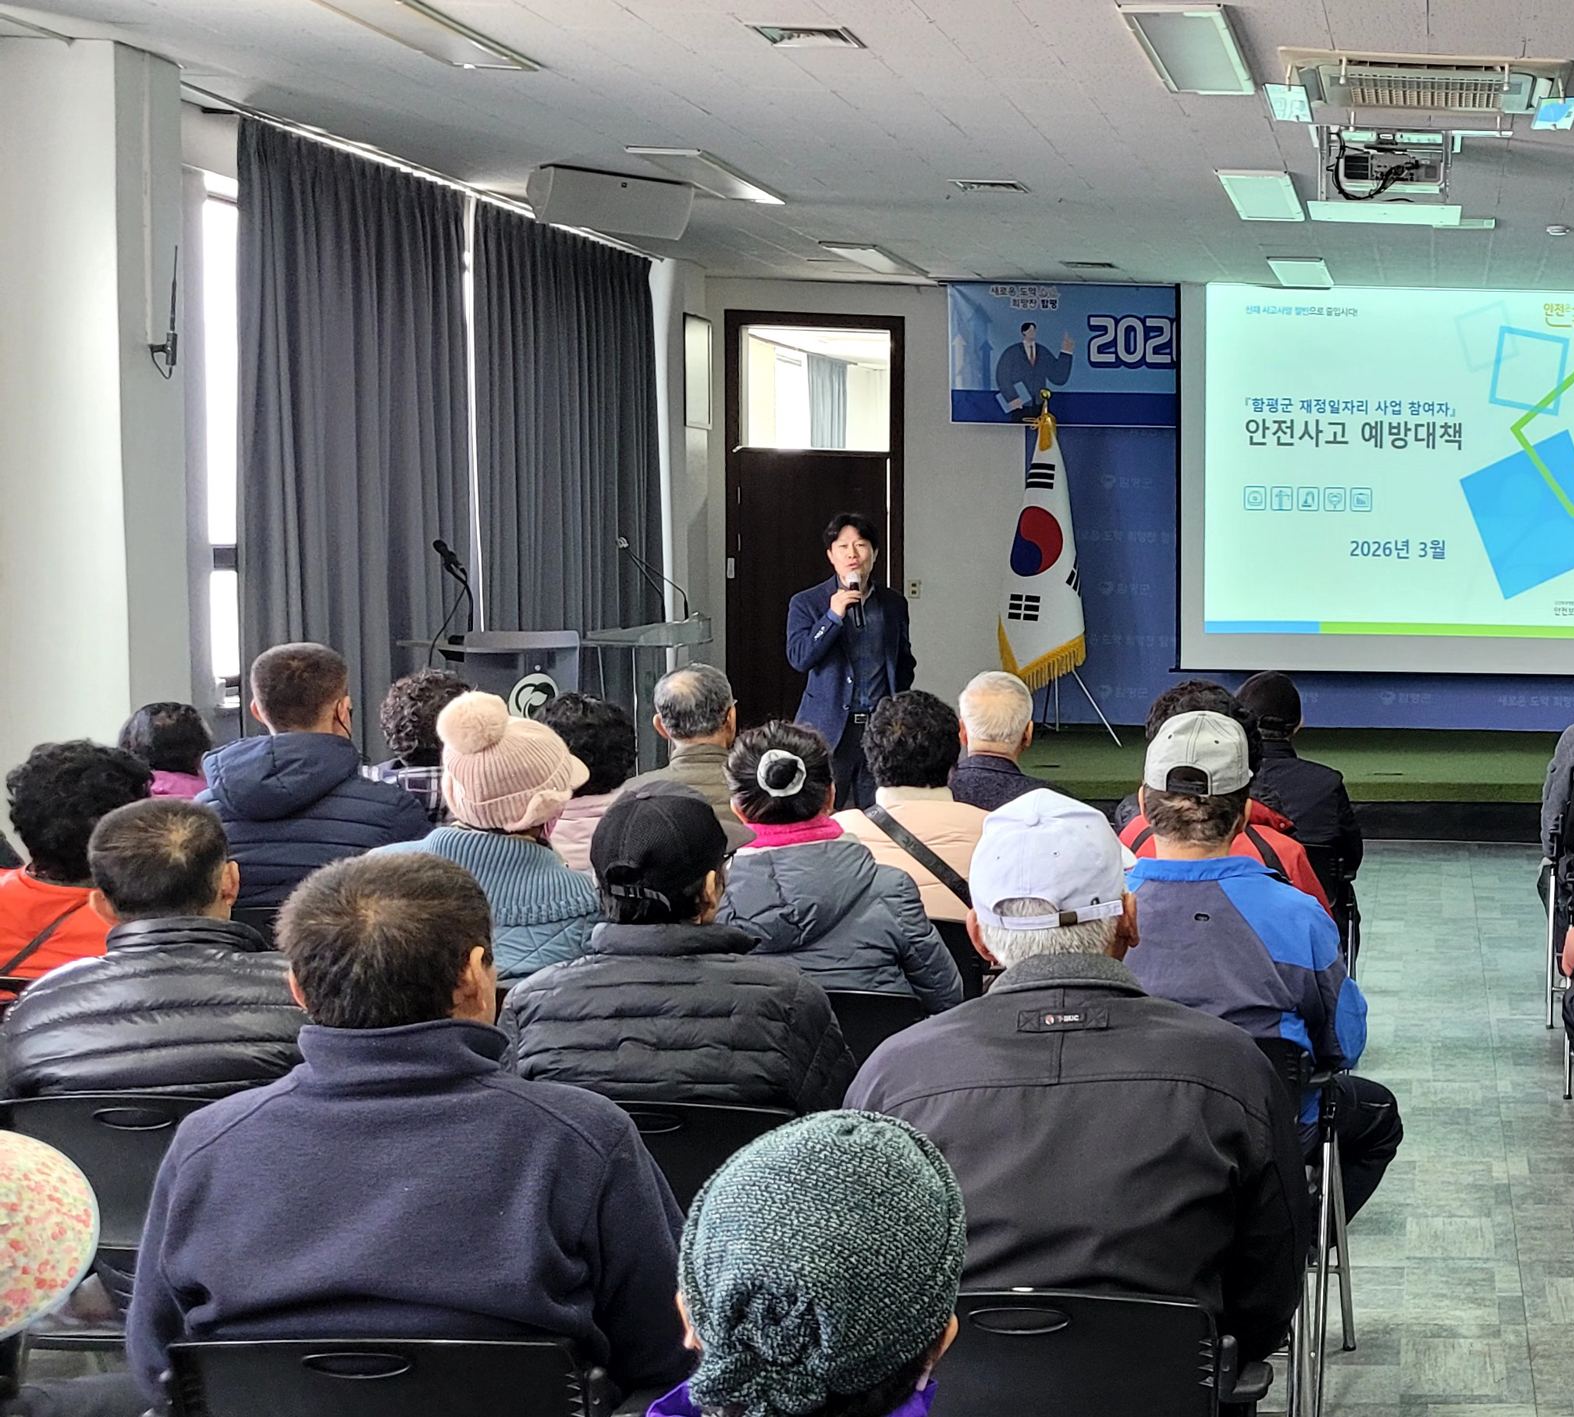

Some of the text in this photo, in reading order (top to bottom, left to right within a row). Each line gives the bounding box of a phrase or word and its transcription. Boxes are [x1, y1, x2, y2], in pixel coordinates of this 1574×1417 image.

[1088, 315, 1176, 365] 202
[1299, 398, 1369, 415] 재정일자리
[1375, 400, 1403, 417] 사업
[1245, 418, 1463, 451] 안전사고 예방대책
[1349, 539, 1446, 560] 2026년 3월
